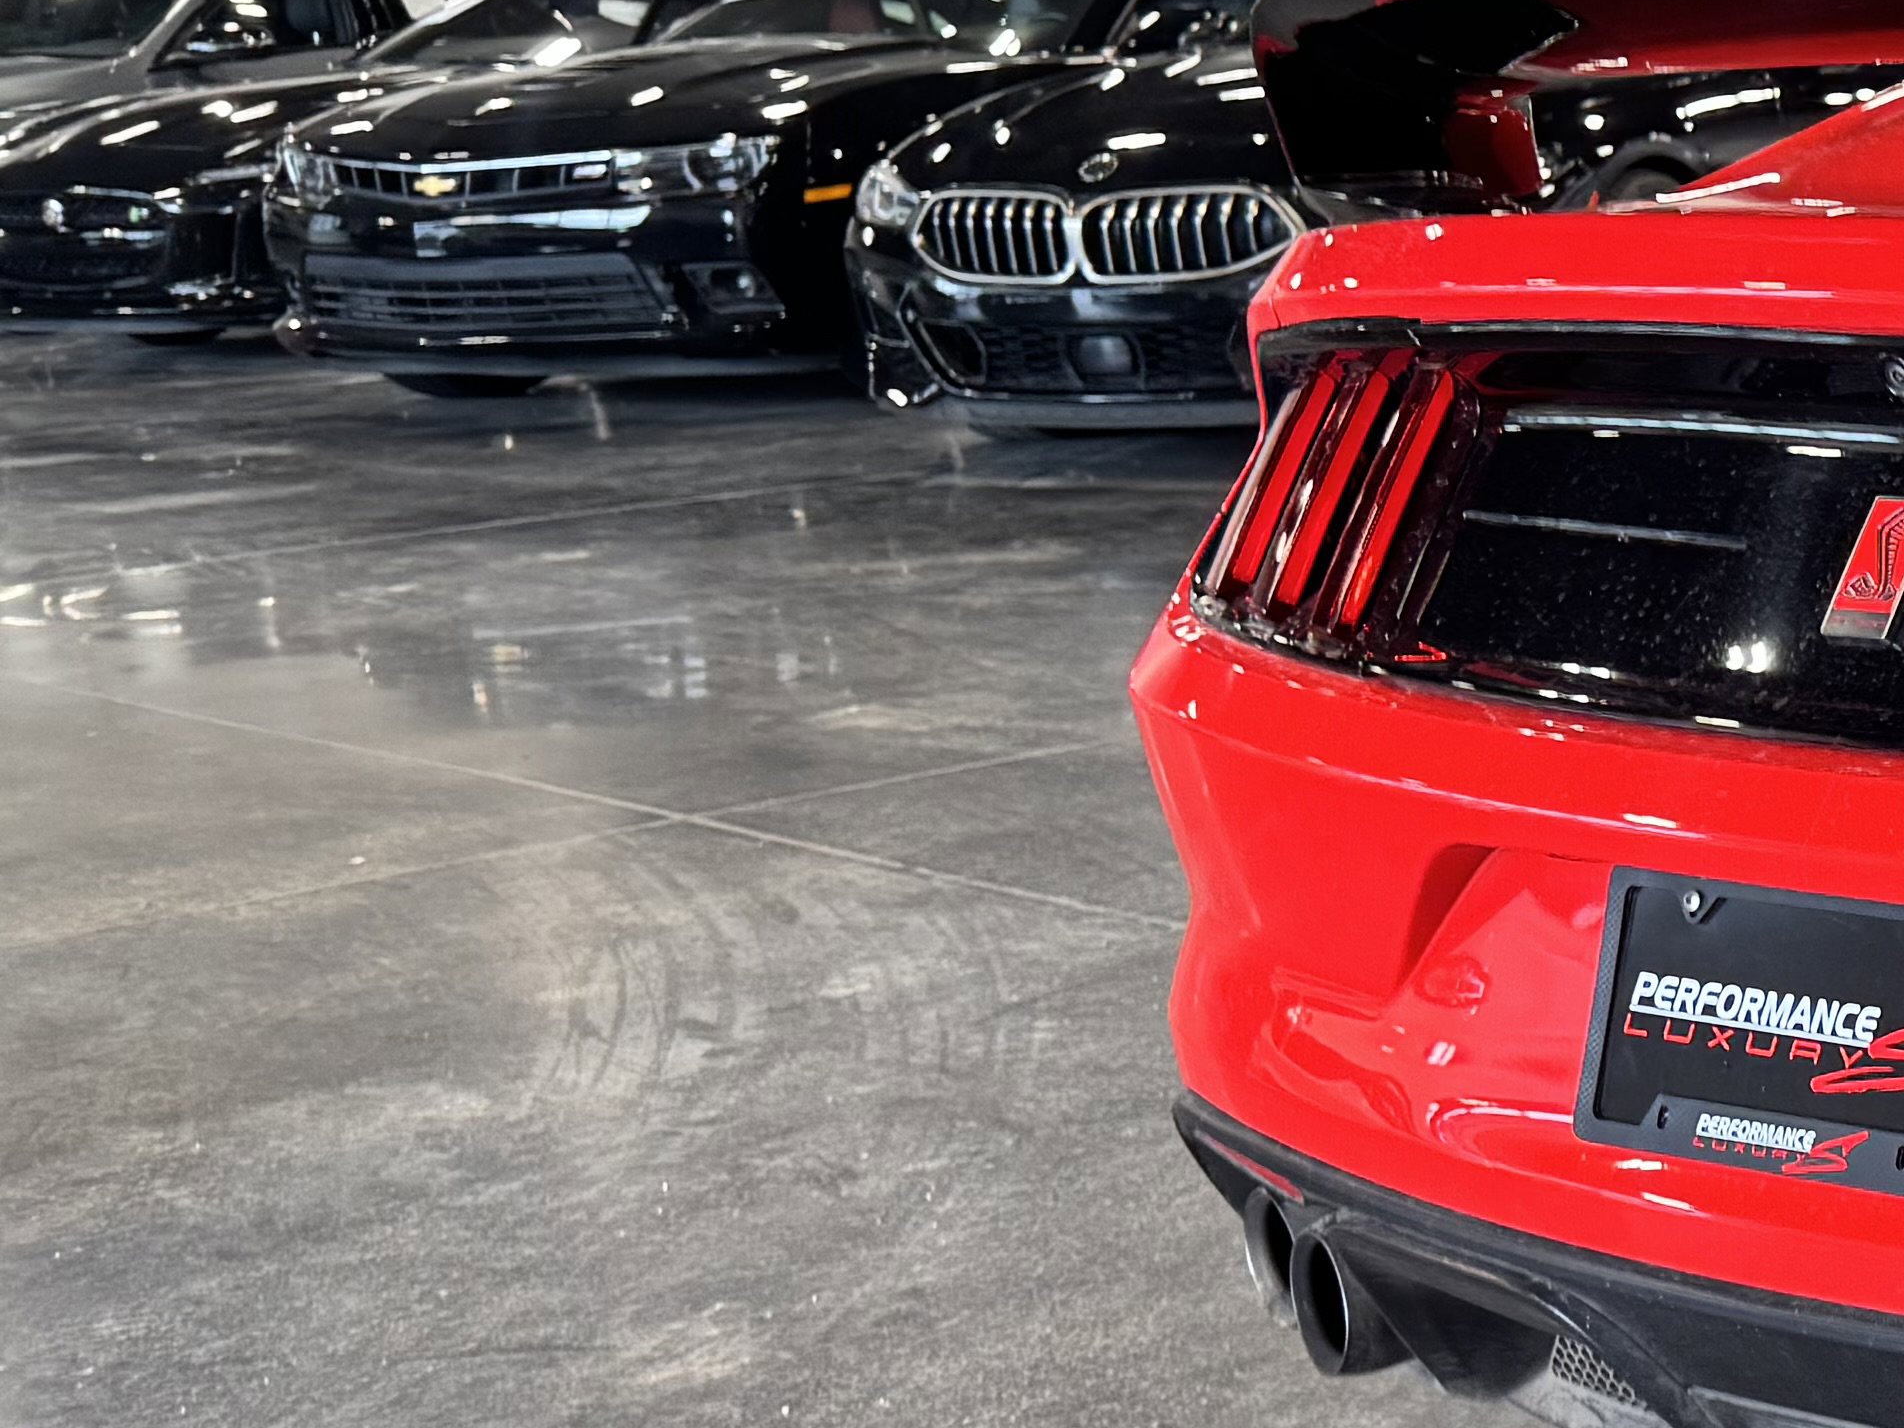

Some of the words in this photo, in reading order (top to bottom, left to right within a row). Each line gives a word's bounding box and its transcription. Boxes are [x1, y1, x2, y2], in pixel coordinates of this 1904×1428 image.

[1630, 971, 1882, 1042] PERFORMANCE
[1623, 1013, 1864, 1070] LUXURY
[1696, 1113, 1816, 1151] PERFORMANCE
